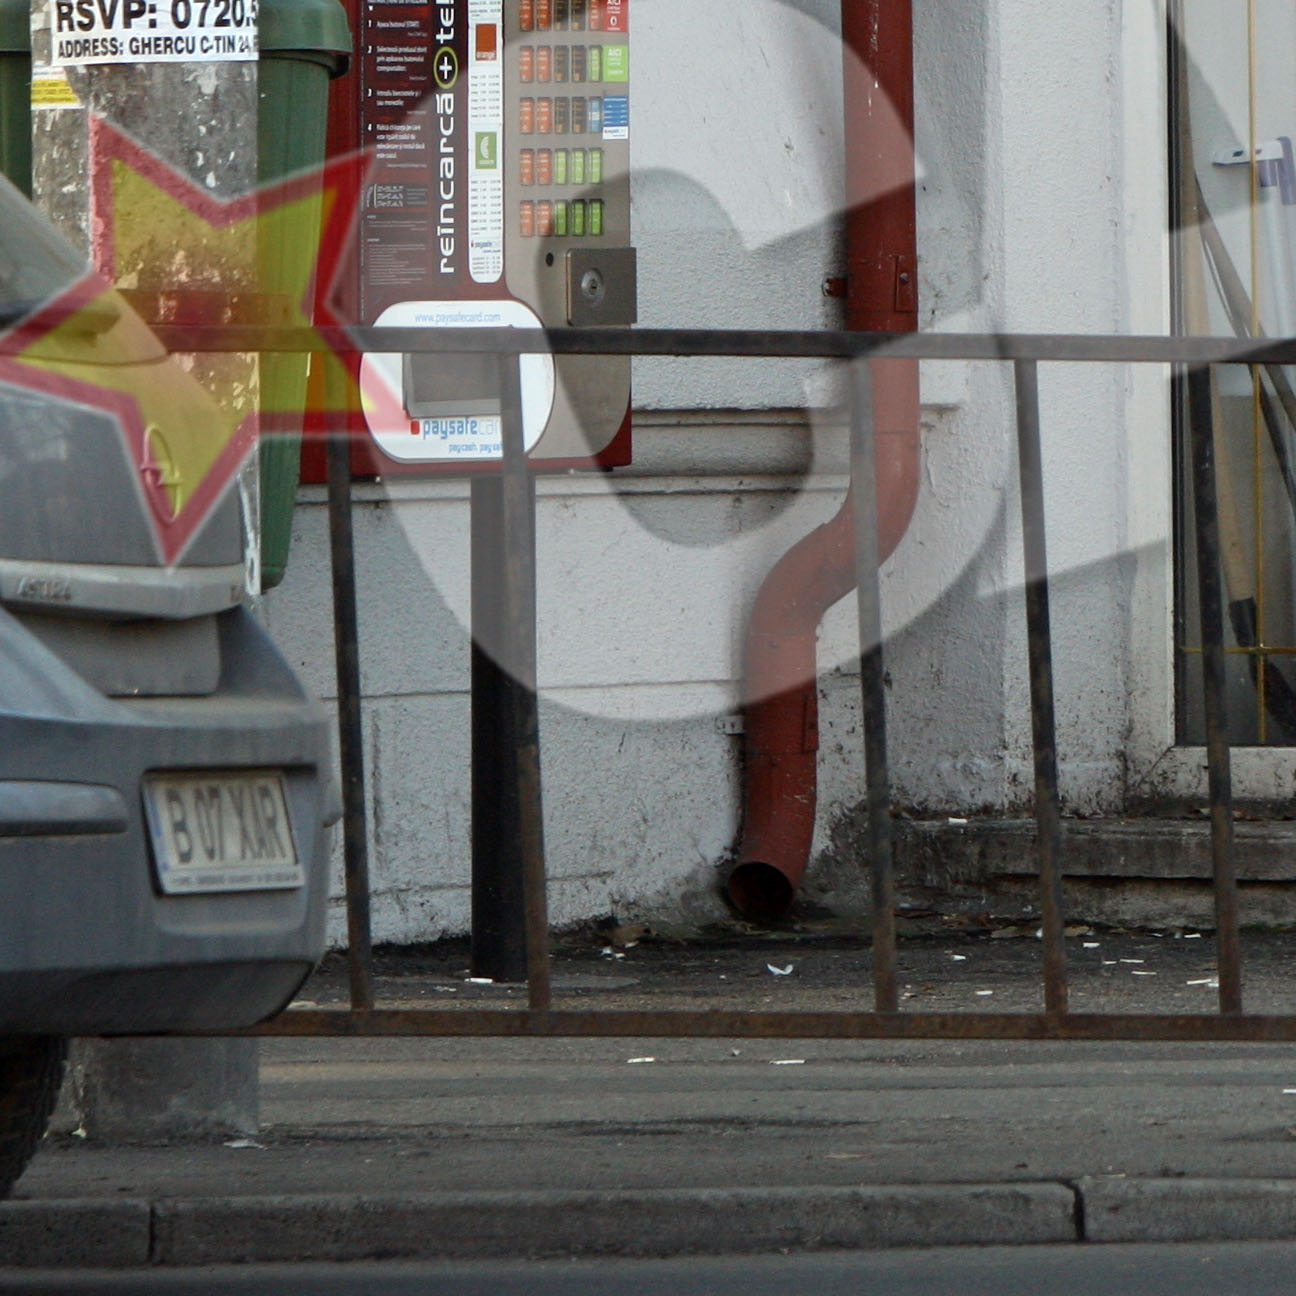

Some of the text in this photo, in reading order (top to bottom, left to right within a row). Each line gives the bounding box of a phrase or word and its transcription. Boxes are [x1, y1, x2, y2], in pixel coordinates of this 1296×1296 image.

[58, 37, 124, 58] ADDRESS:
[129, 35, 195, 55] GHERCU
[201, 34, 236, 54] C-TIN
[165, 787, 193, 864] B
